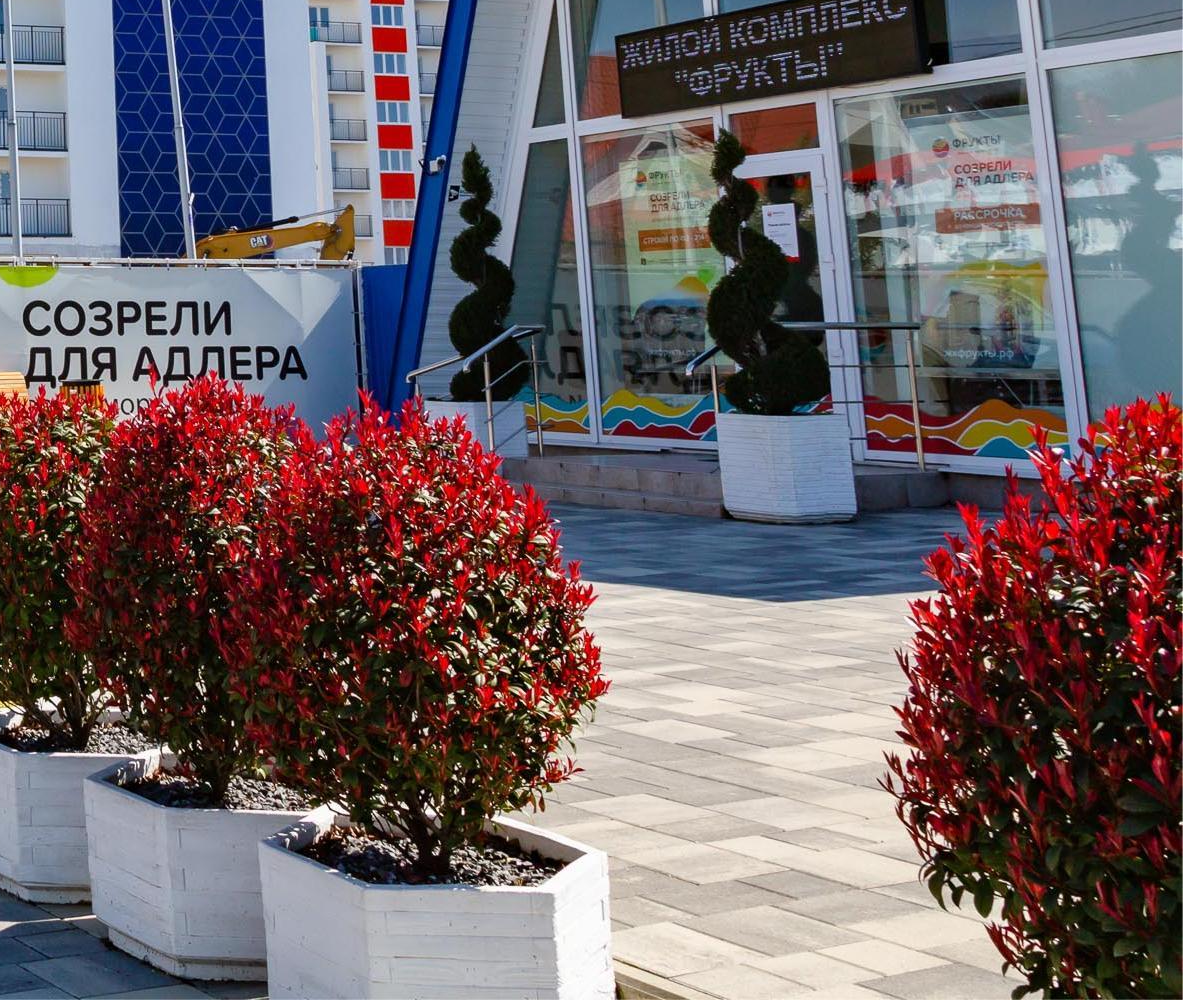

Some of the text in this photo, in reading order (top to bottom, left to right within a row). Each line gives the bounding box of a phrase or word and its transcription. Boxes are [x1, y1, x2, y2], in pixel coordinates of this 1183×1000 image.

[621, 19, 721, 69] ЖИЛОЙ
[674, 42, 844, 96] "ФРУКТЫ"
[954, 160, 1012, 175] СОЗРЕЛИ
[954, 207, 1024, 221] РАССРОЧКА
[250, 235, 268, 248] CAT
[22, 300, 232, 337] СОЗРЕЛИ
[24, 346, 308, 389] ДЛЯ АДЛЕРА
